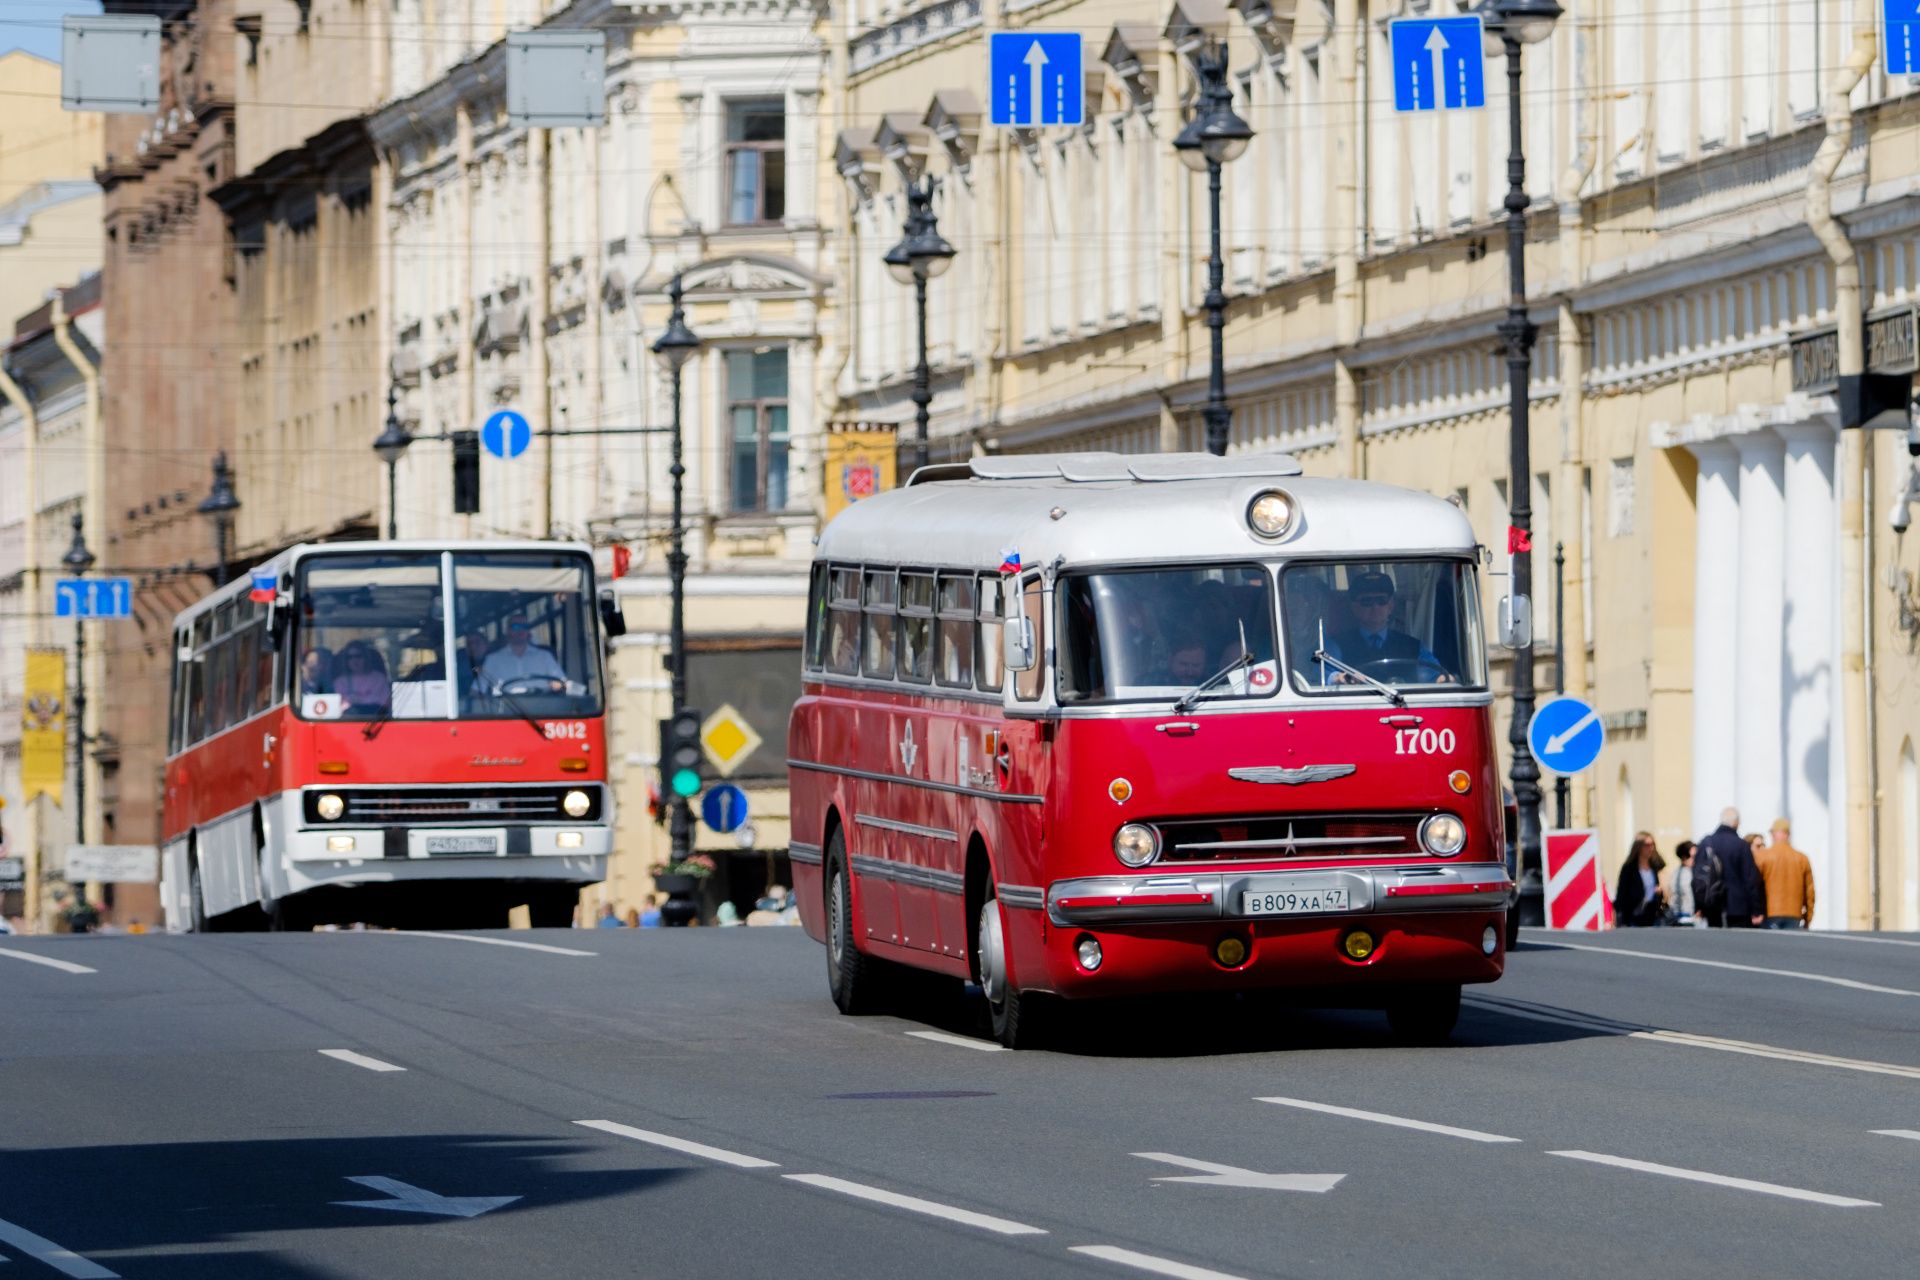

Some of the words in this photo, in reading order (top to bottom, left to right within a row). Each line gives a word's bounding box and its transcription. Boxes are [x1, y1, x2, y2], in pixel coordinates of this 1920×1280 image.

[544, 721, 586, 739] 5012
[1395, 728, 1456, 754] 1700
[1325, 890, 1342, 904] 47
